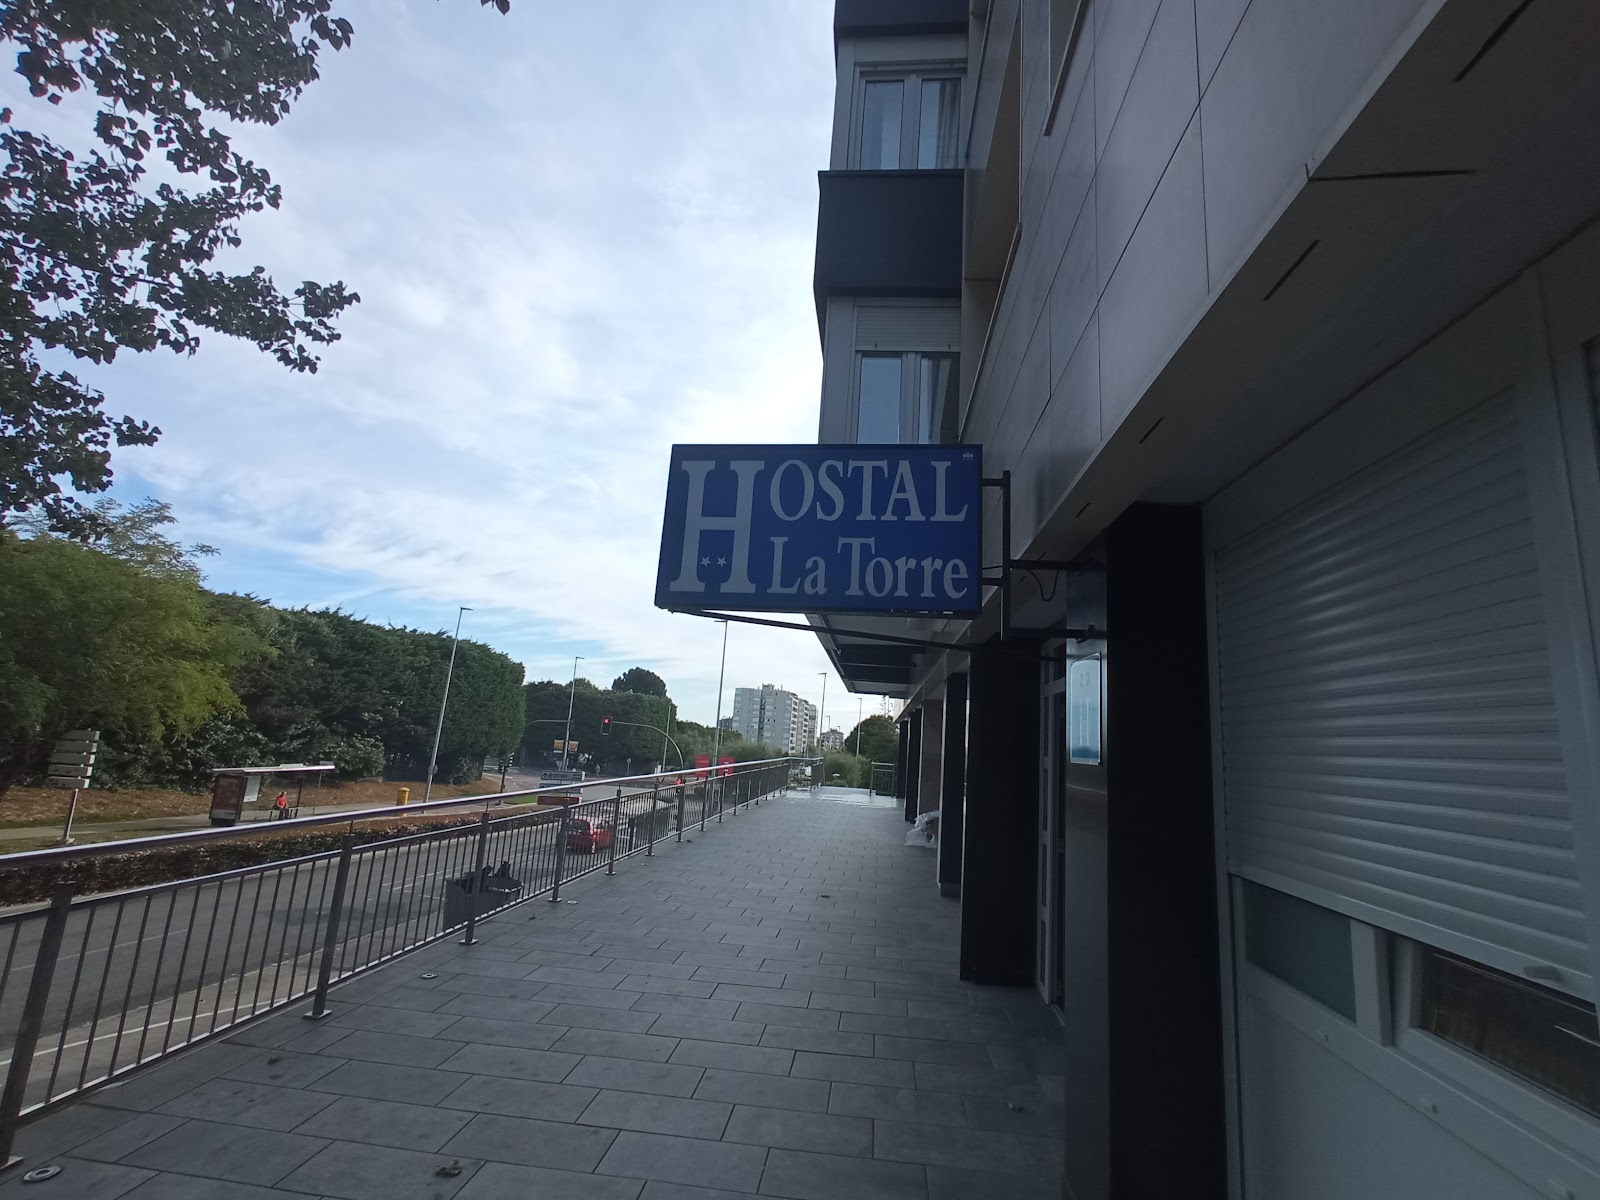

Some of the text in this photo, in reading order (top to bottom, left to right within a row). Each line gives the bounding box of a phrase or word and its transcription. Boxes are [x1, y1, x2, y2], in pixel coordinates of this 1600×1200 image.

[669, 459, 969, 593] HOSTAL
[766, 536, 969, 598] La Torre
